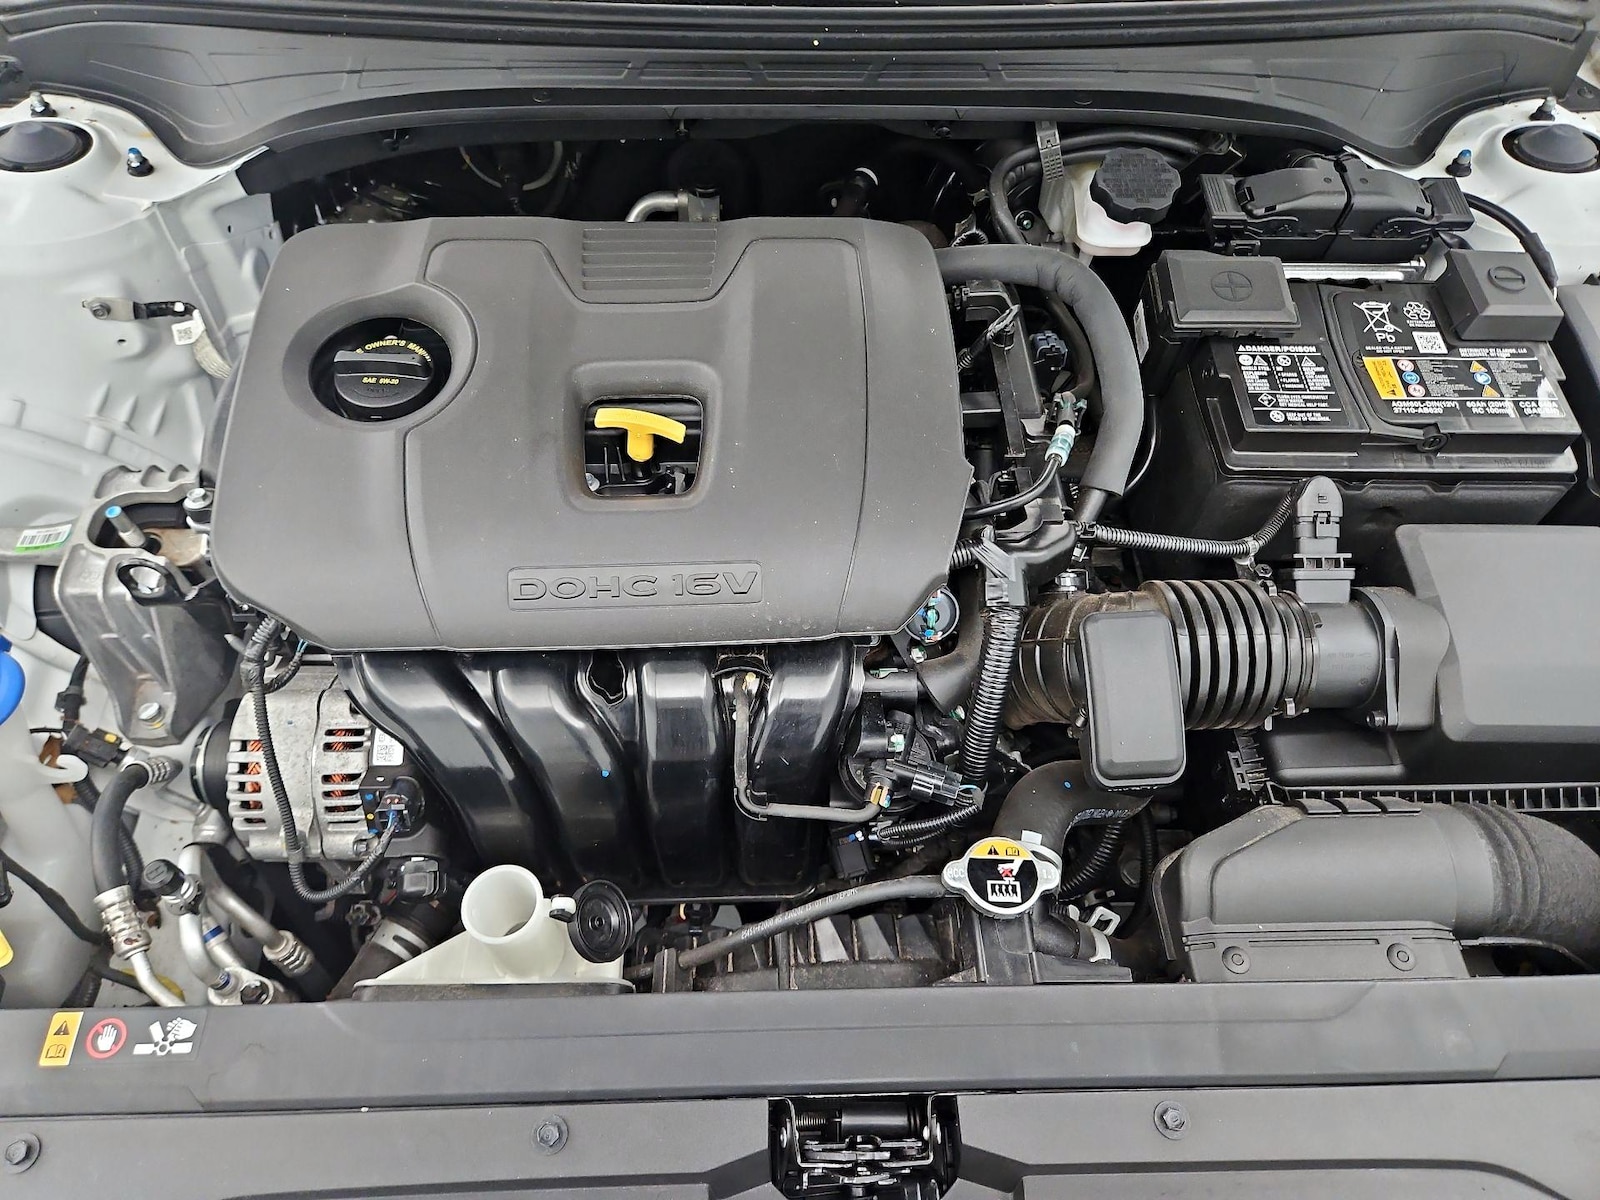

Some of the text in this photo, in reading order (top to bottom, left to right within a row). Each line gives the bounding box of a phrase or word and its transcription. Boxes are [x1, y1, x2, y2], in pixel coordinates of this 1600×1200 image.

[1376, 332, 1396, 343] Pb
[364, 340, 406, 350] OWNER'S
[512, 571, 758, 600] DOHC 16V
